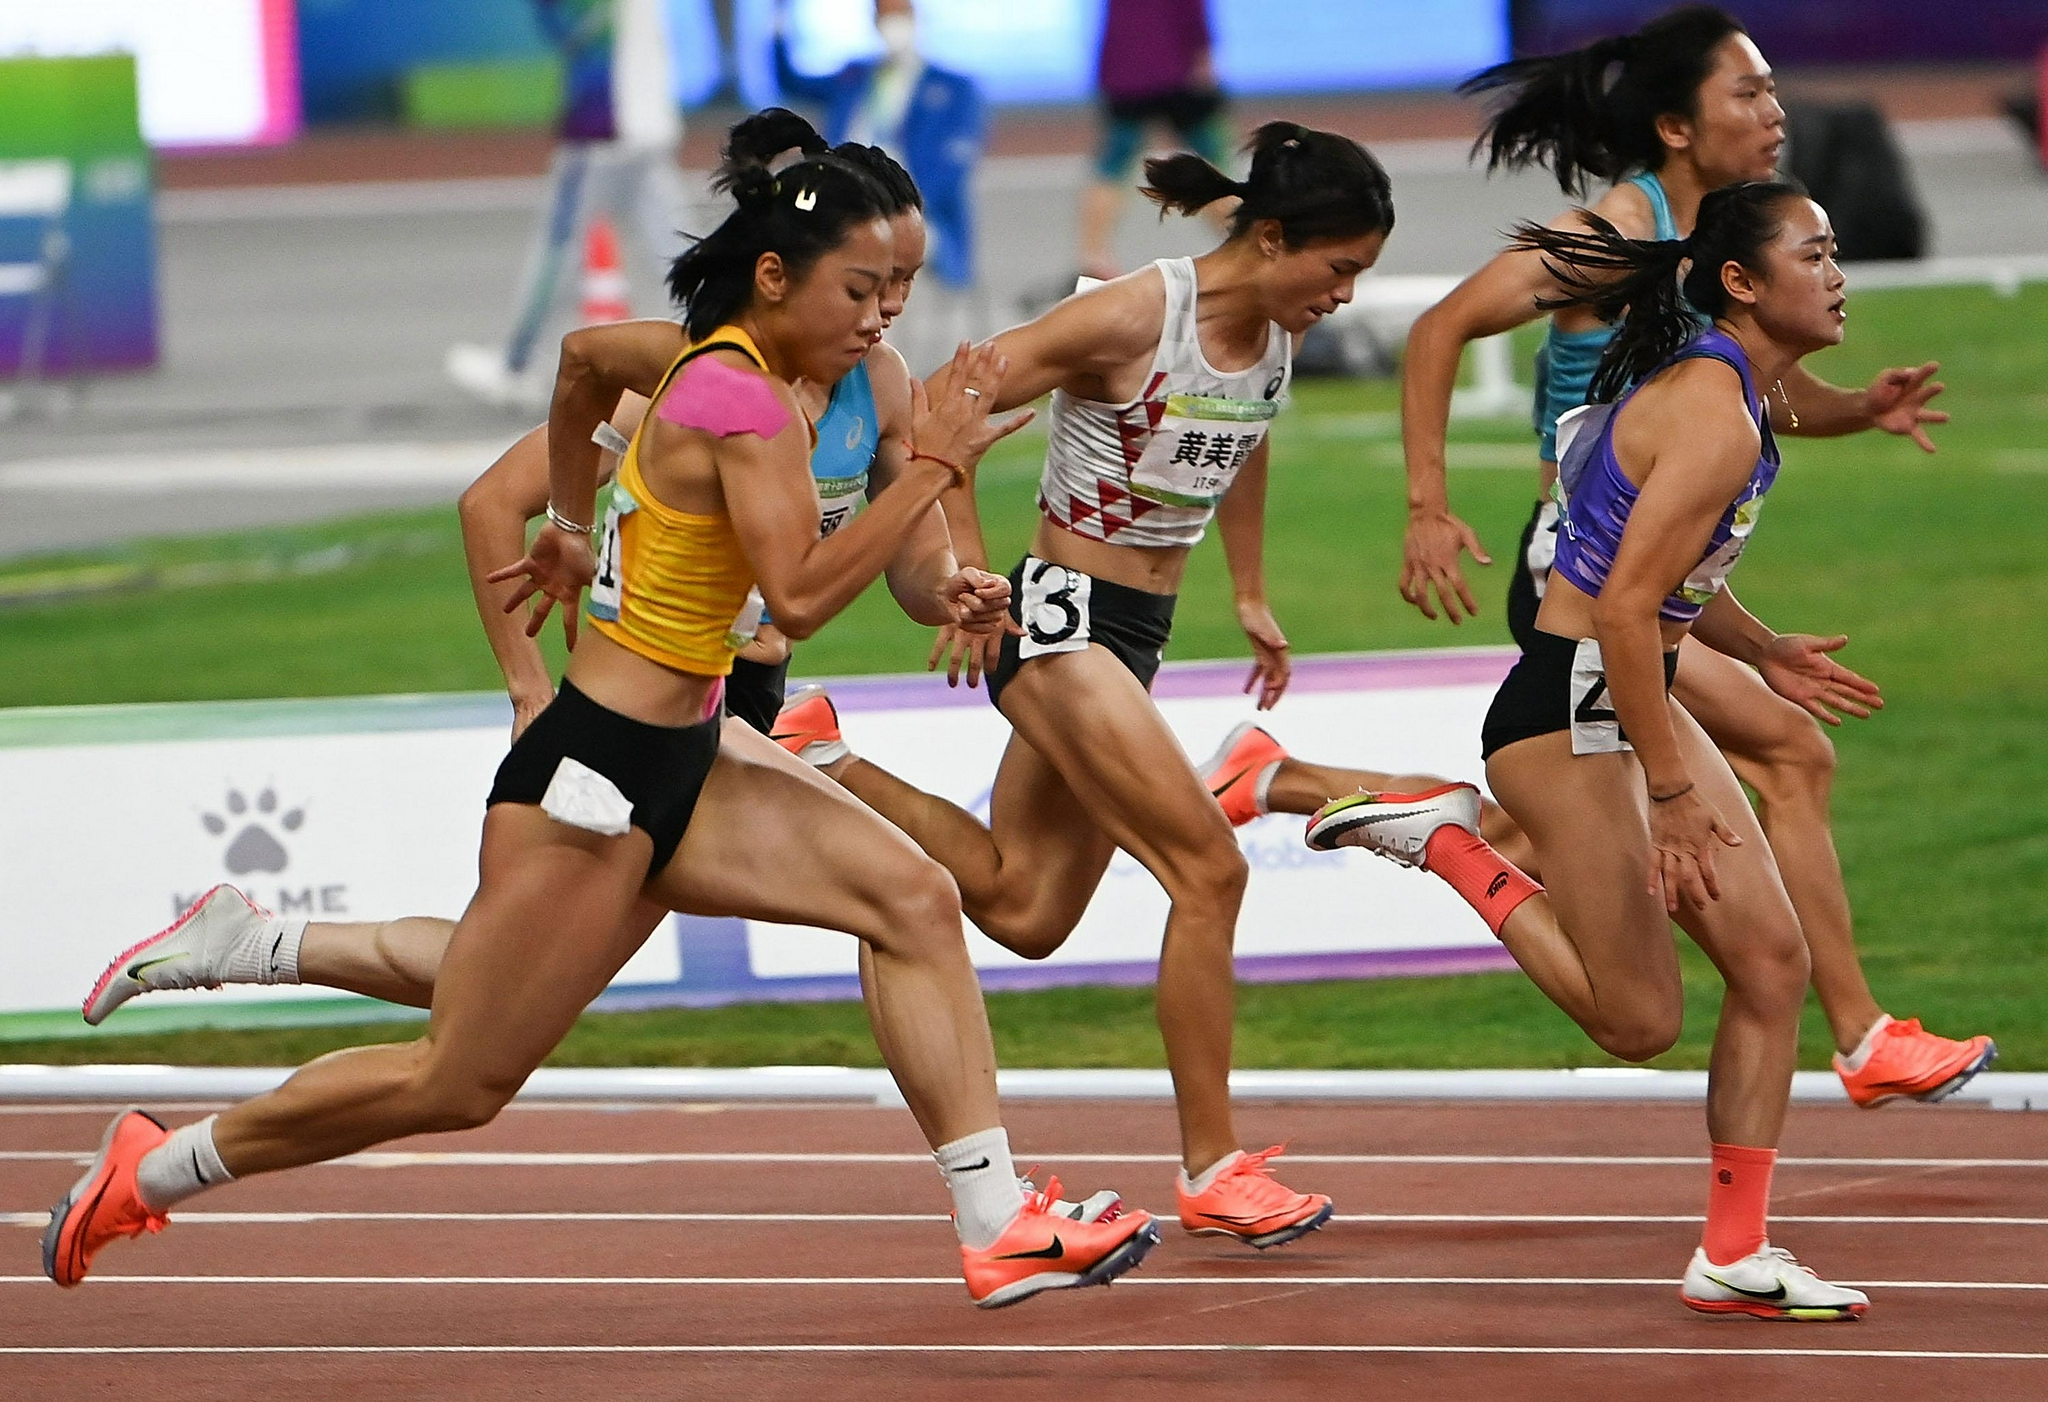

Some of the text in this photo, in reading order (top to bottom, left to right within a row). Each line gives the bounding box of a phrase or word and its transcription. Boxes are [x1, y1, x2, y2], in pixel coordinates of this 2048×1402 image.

[597, 526, 614, 588] 1
[1027, 562, 1080, 645] 3
[172, 884, 348, 919] KME
